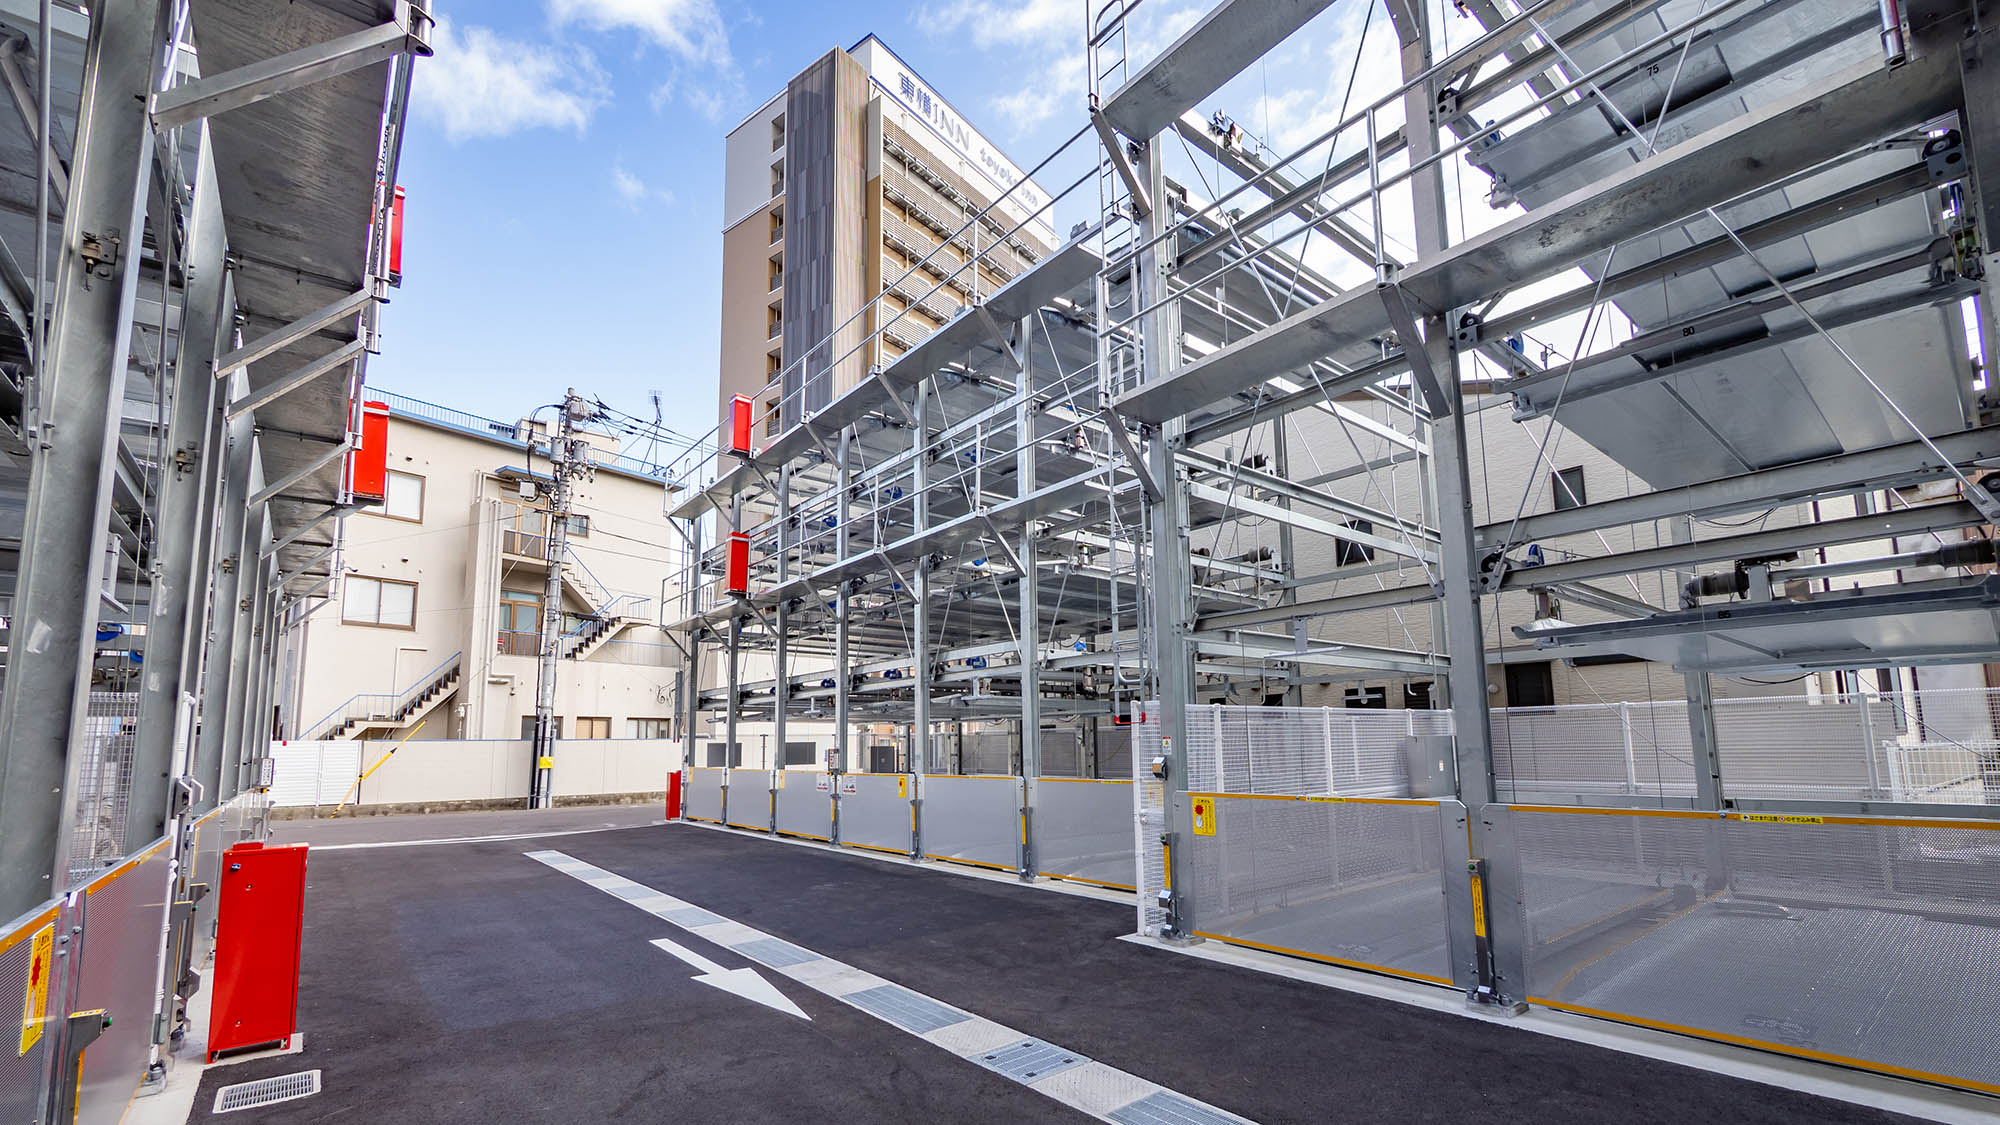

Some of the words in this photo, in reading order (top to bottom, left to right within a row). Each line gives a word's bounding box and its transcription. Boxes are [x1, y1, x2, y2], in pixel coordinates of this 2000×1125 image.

[1646, 63, 1660, 77] 75
[898, 71, 969, 151] 東横INN
[1682, 325, 1695, 337] 80
